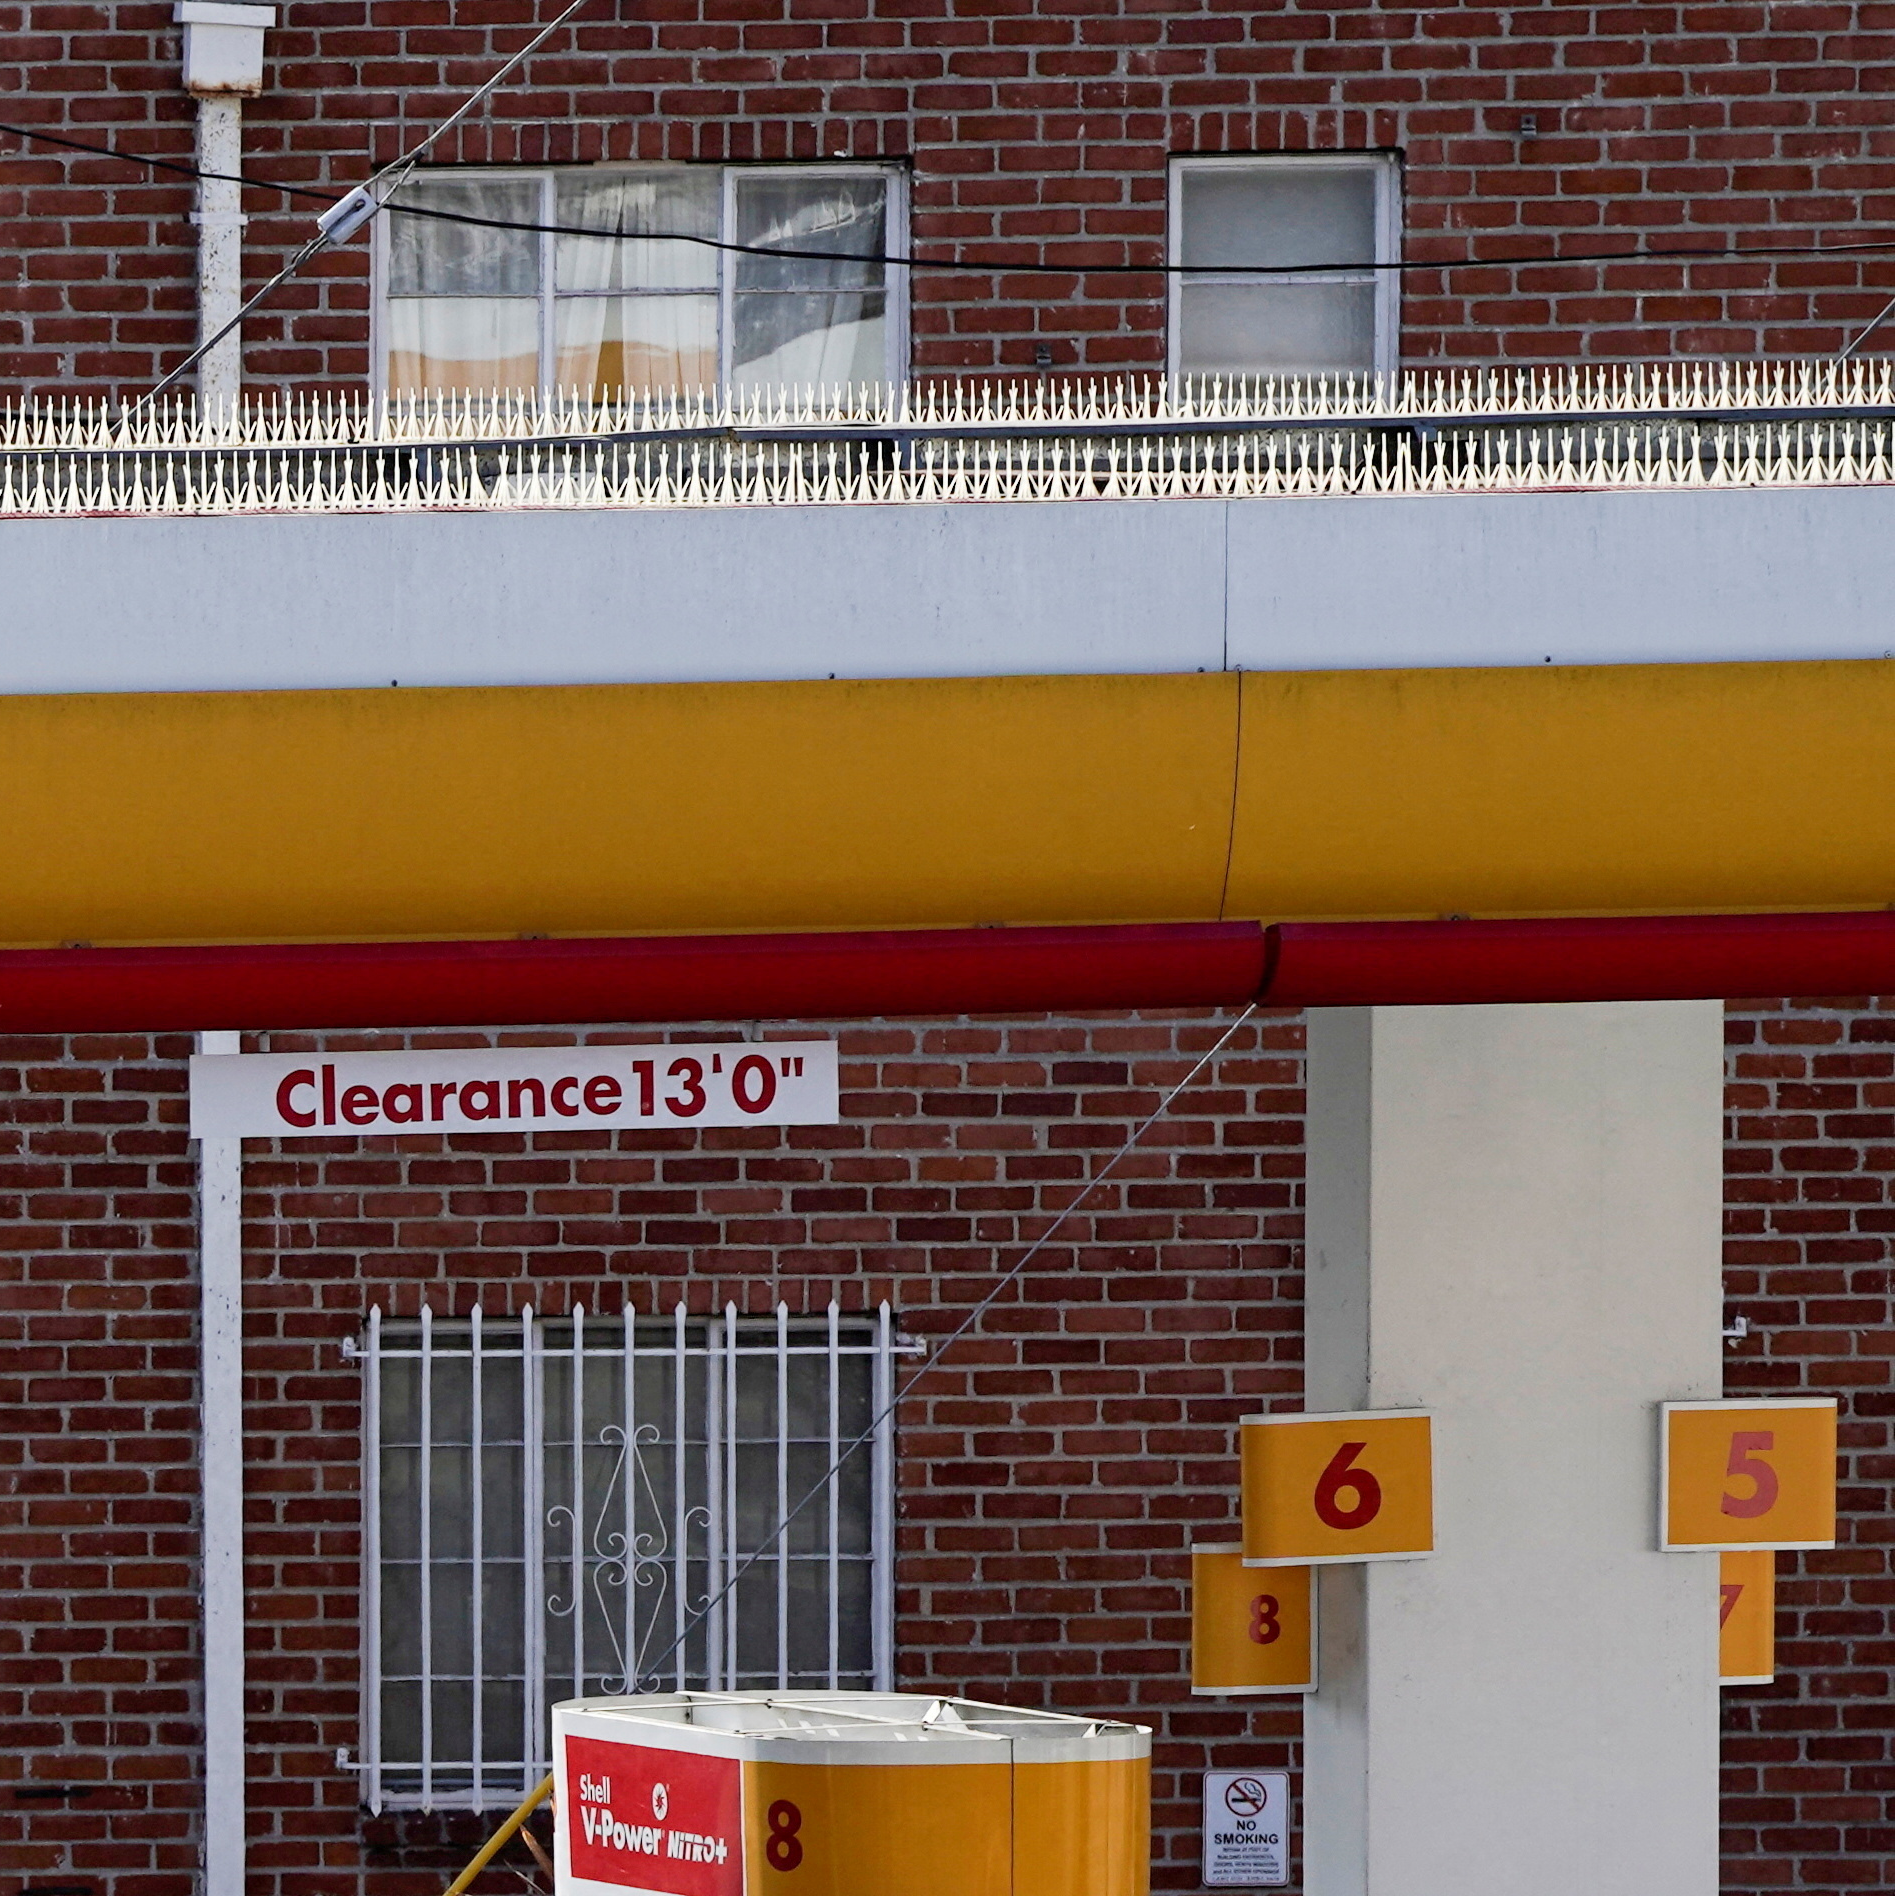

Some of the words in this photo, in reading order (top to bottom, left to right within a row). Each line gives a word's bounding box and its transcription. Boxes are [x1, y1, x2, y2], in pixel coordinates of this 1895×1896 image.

[276, 1064, 622, 1128] Clearance
[1314, 1442, 1382, 1530] 6
[1720, 1431, 1779, 1519] 5
[1248, 1594, 1281, 1645] 8
[580, 1773, 611, 1805] Shell
[580, 1805, 662, 1856] V-Power
[766, 1800, 803, 1872] 8
[1213, 1833, 1279, 1845] SMOKING
[1236, 1820, 1257, 1831] NO
